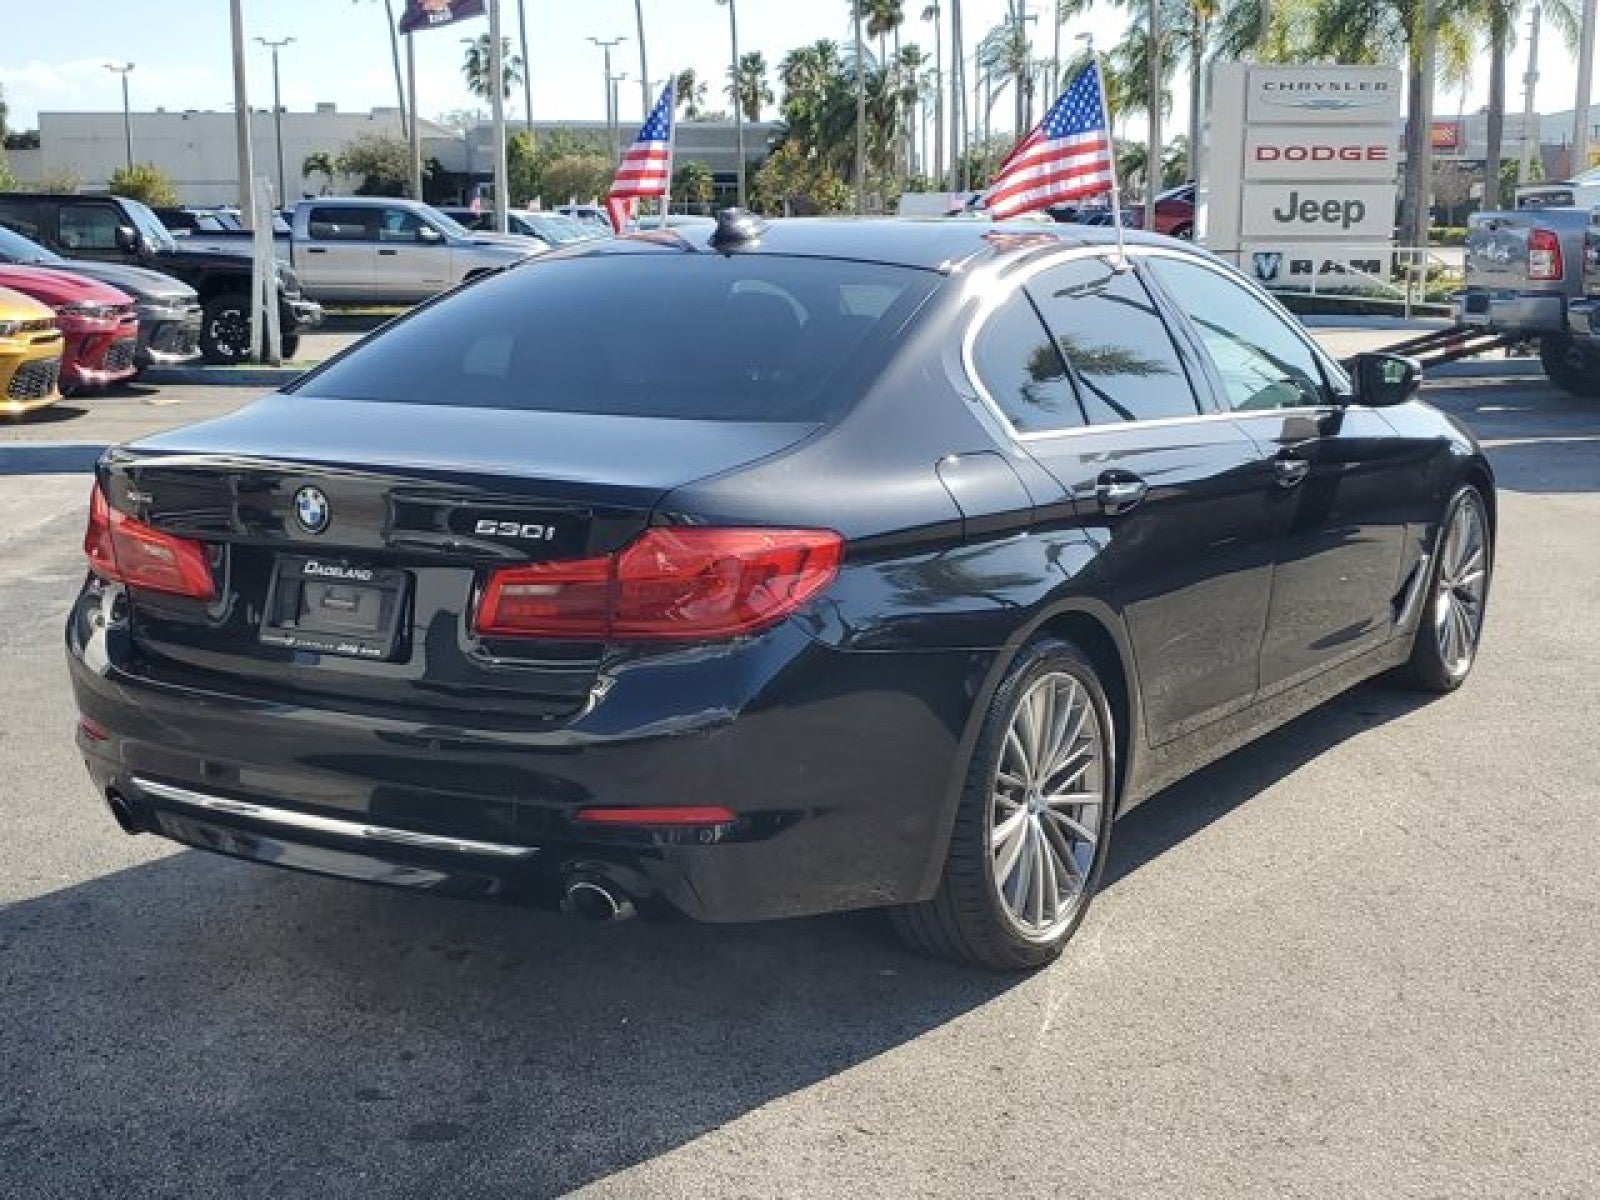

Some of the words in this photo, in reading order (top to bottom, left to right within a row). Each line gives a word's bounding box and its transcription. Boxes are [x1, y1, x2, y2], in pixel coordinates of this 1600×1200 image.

[1256, 146, 1388, 161] DODGE
[1272, 191, 1366, 229] Jeep
[1289, 259, 1381, 275] RAM
[474, 519, 556, 541] 530i
